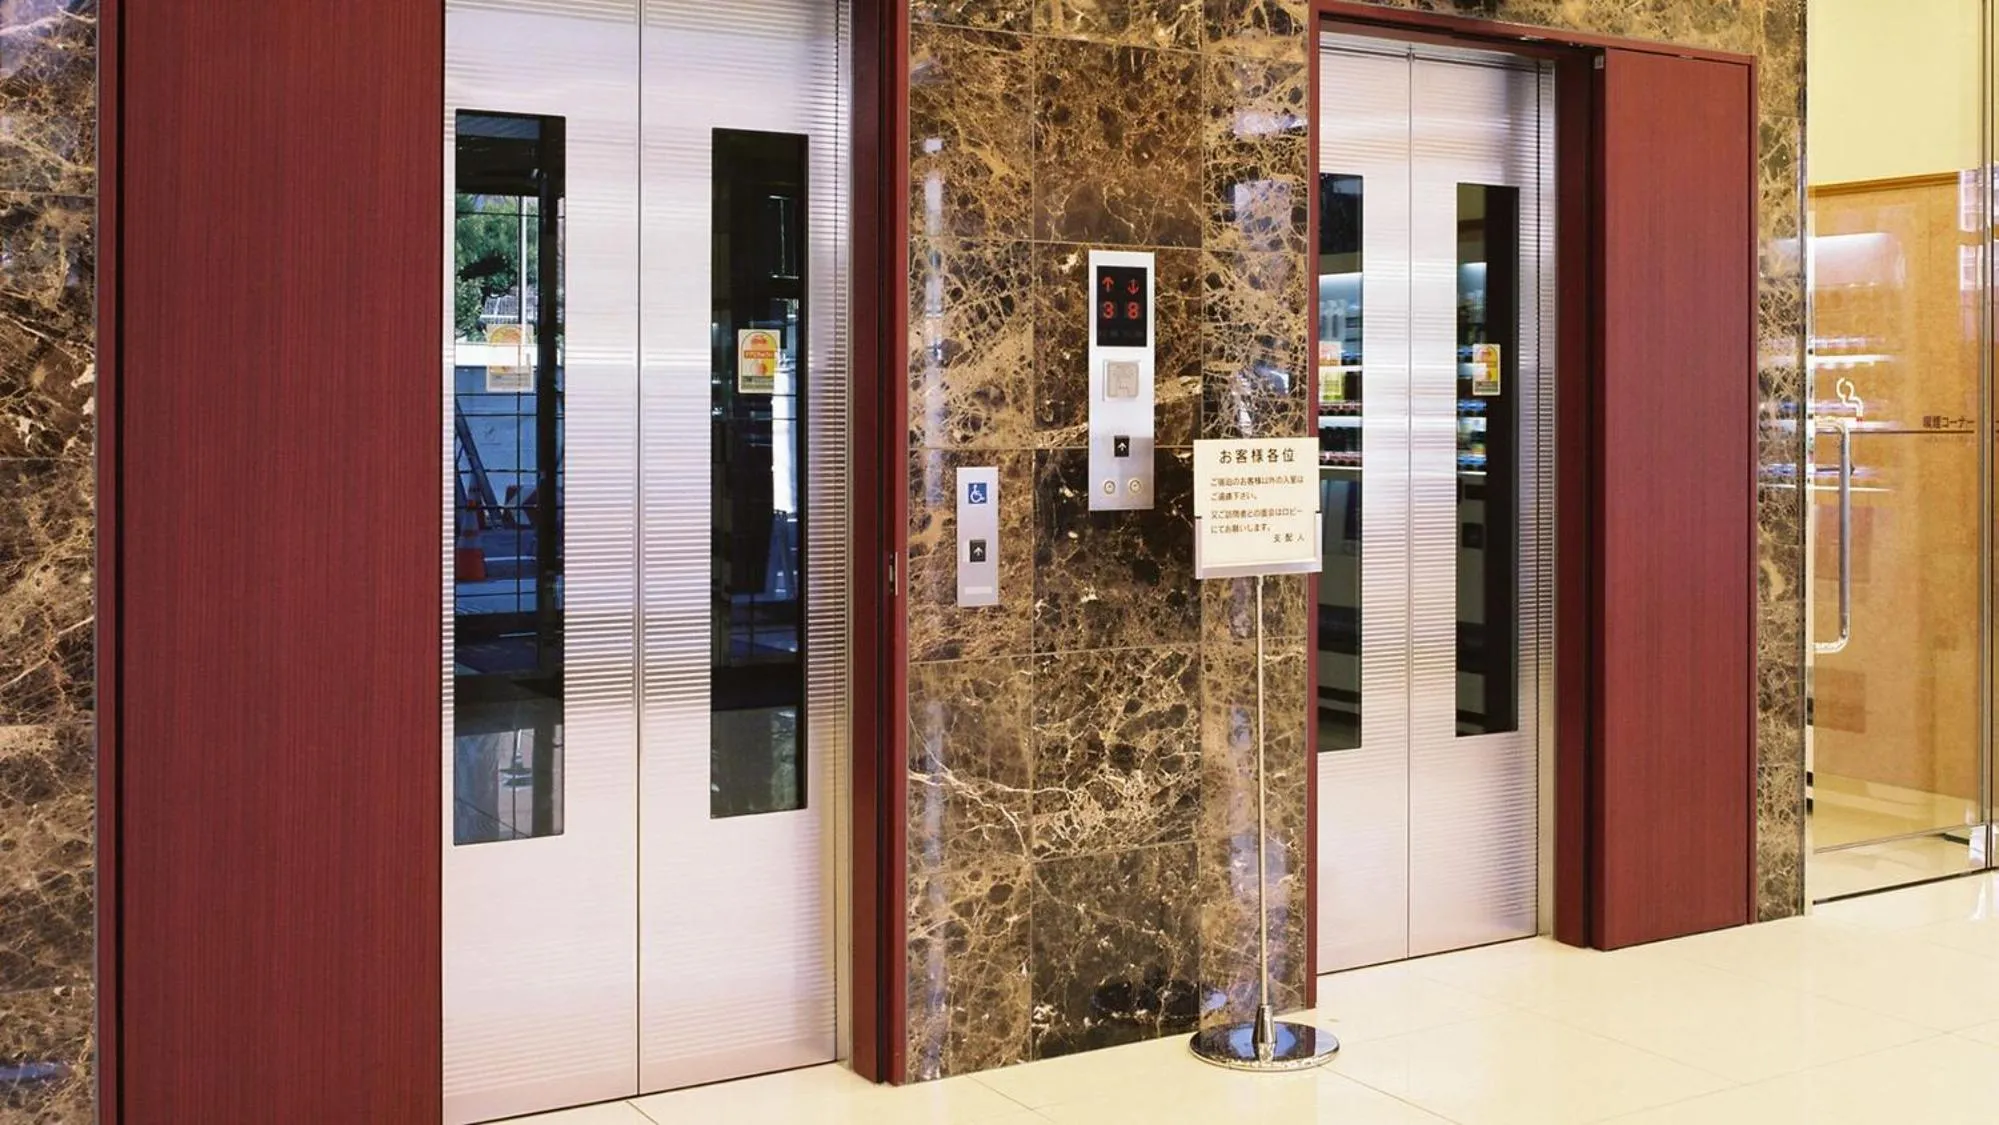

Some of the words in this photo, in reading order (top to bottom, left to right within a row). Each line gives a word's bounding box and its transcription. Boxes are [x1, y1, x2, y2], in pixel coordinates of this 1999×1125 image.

[1103, 301, 1114, 319] 3
[1127, 301, 1139, 320] 8
[1219, 448, 1295, 464] お客様各位
